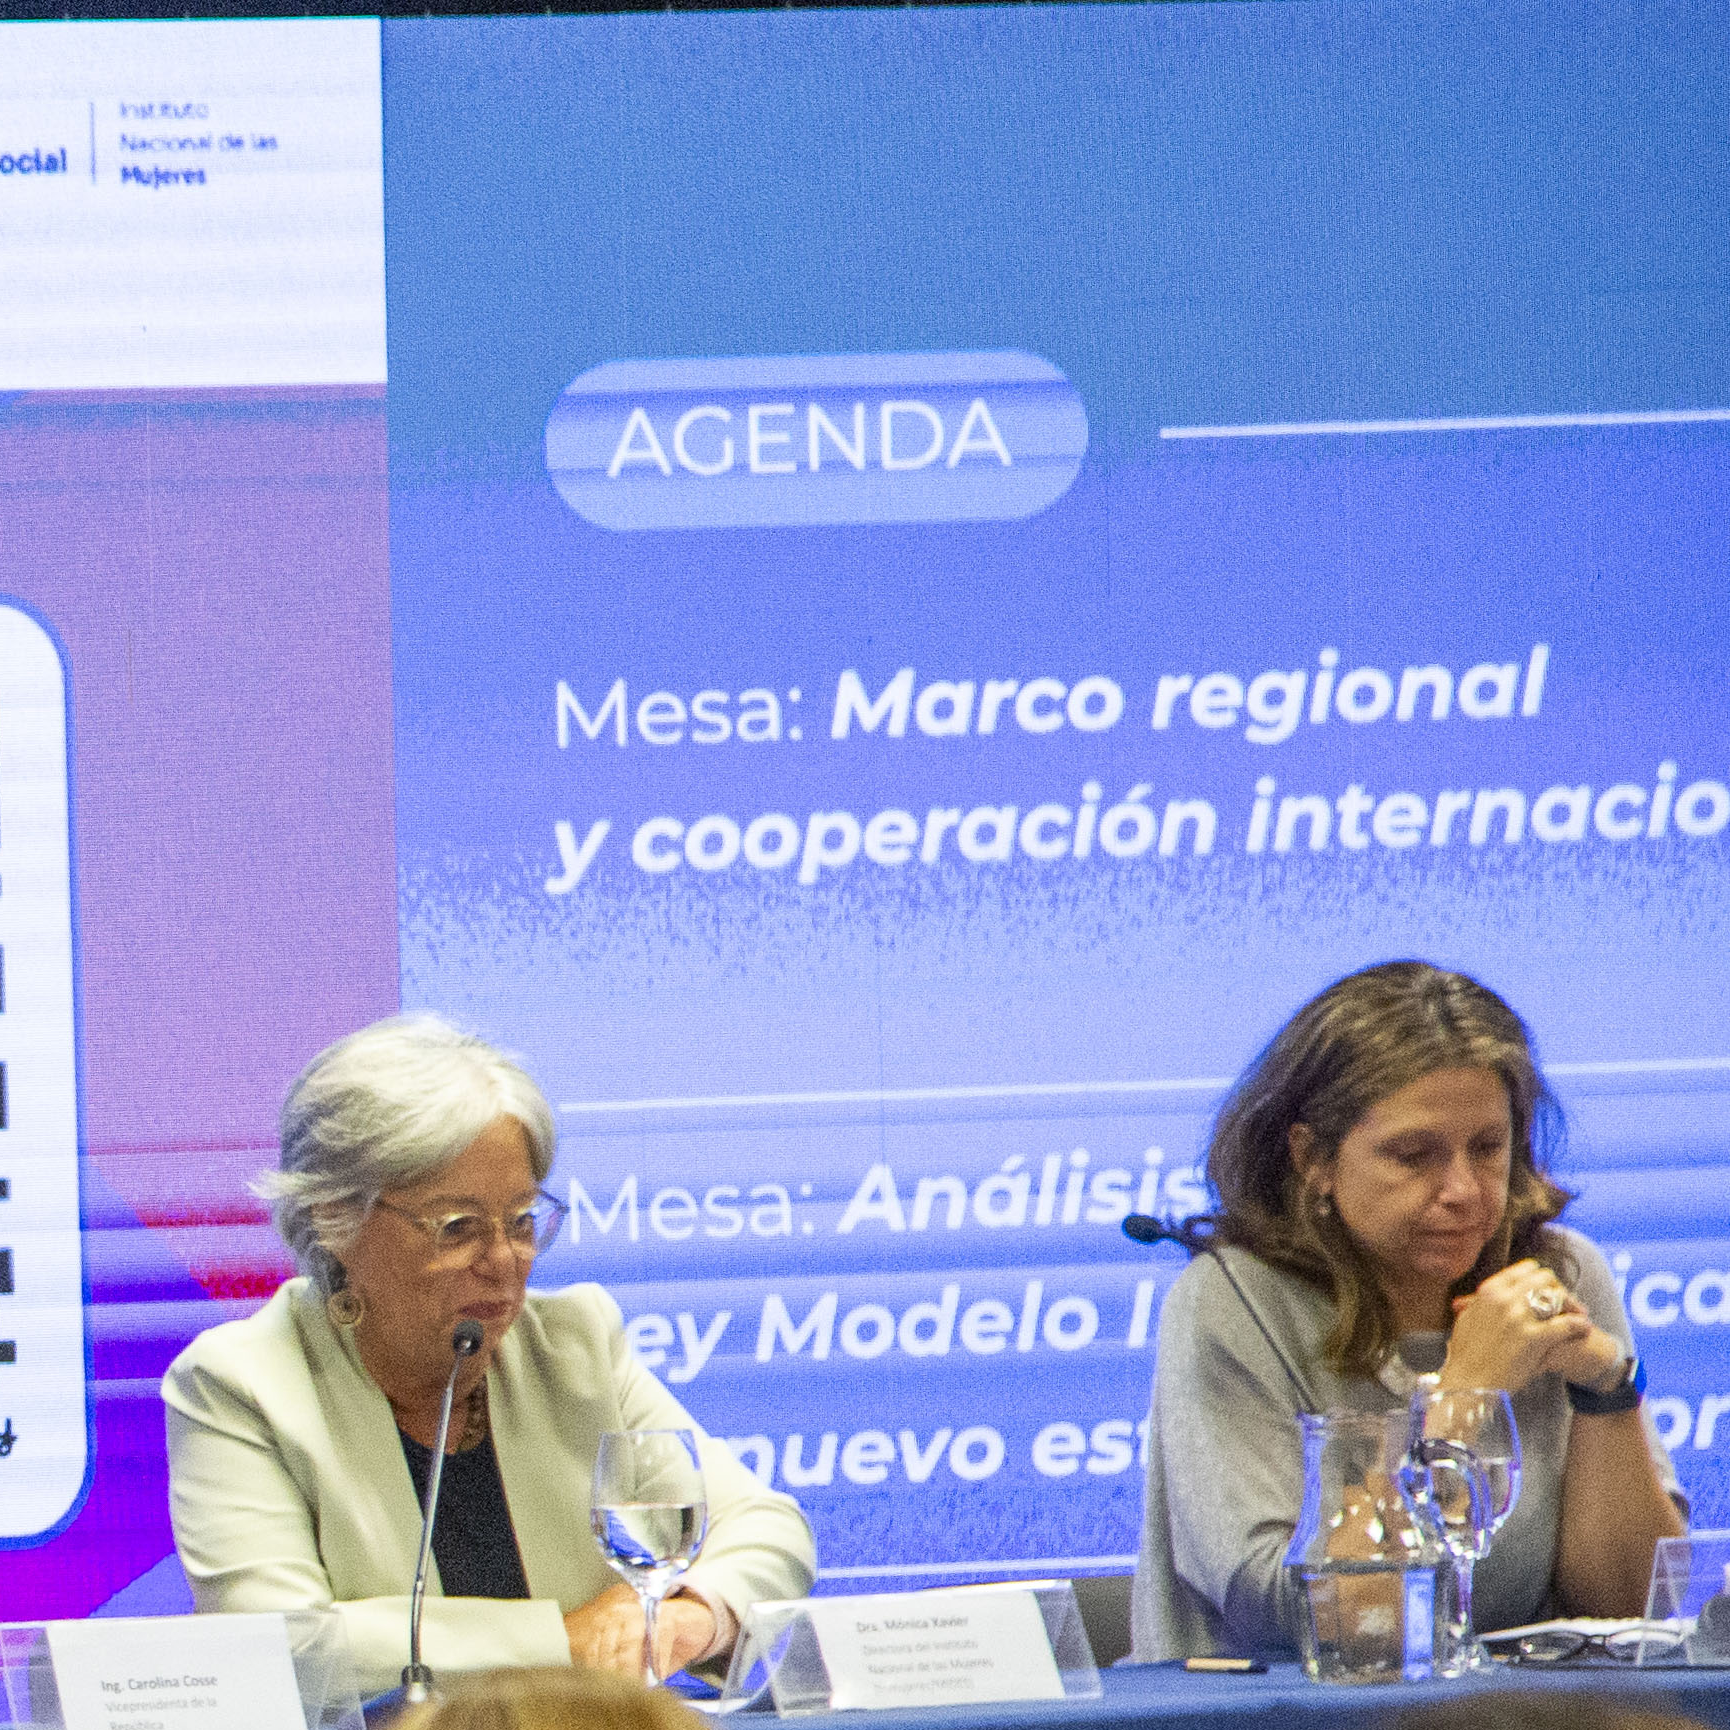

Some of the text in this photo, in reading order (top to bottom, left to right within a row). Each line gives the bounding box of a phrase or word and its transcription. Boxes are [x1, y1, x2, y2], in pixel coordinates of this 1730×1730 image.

[119, 131, 213, 151] Nacional
[120, 165, 207, 190] Mujeres
[606, 396, 1014, 479] AGENDA
[553, 641, 1552, 750] Mesa: Marco regional
[543, 758, 1730, 894] y cooperación internacio
[568, 1146, 1209, 1244] Mesa: Análisis
[625, 1309, 732, 1384] ey
[754, 1279, 1099, 1364] Modelo
[100, 1674, 219, 1694] Ing. Carolina Cosse
